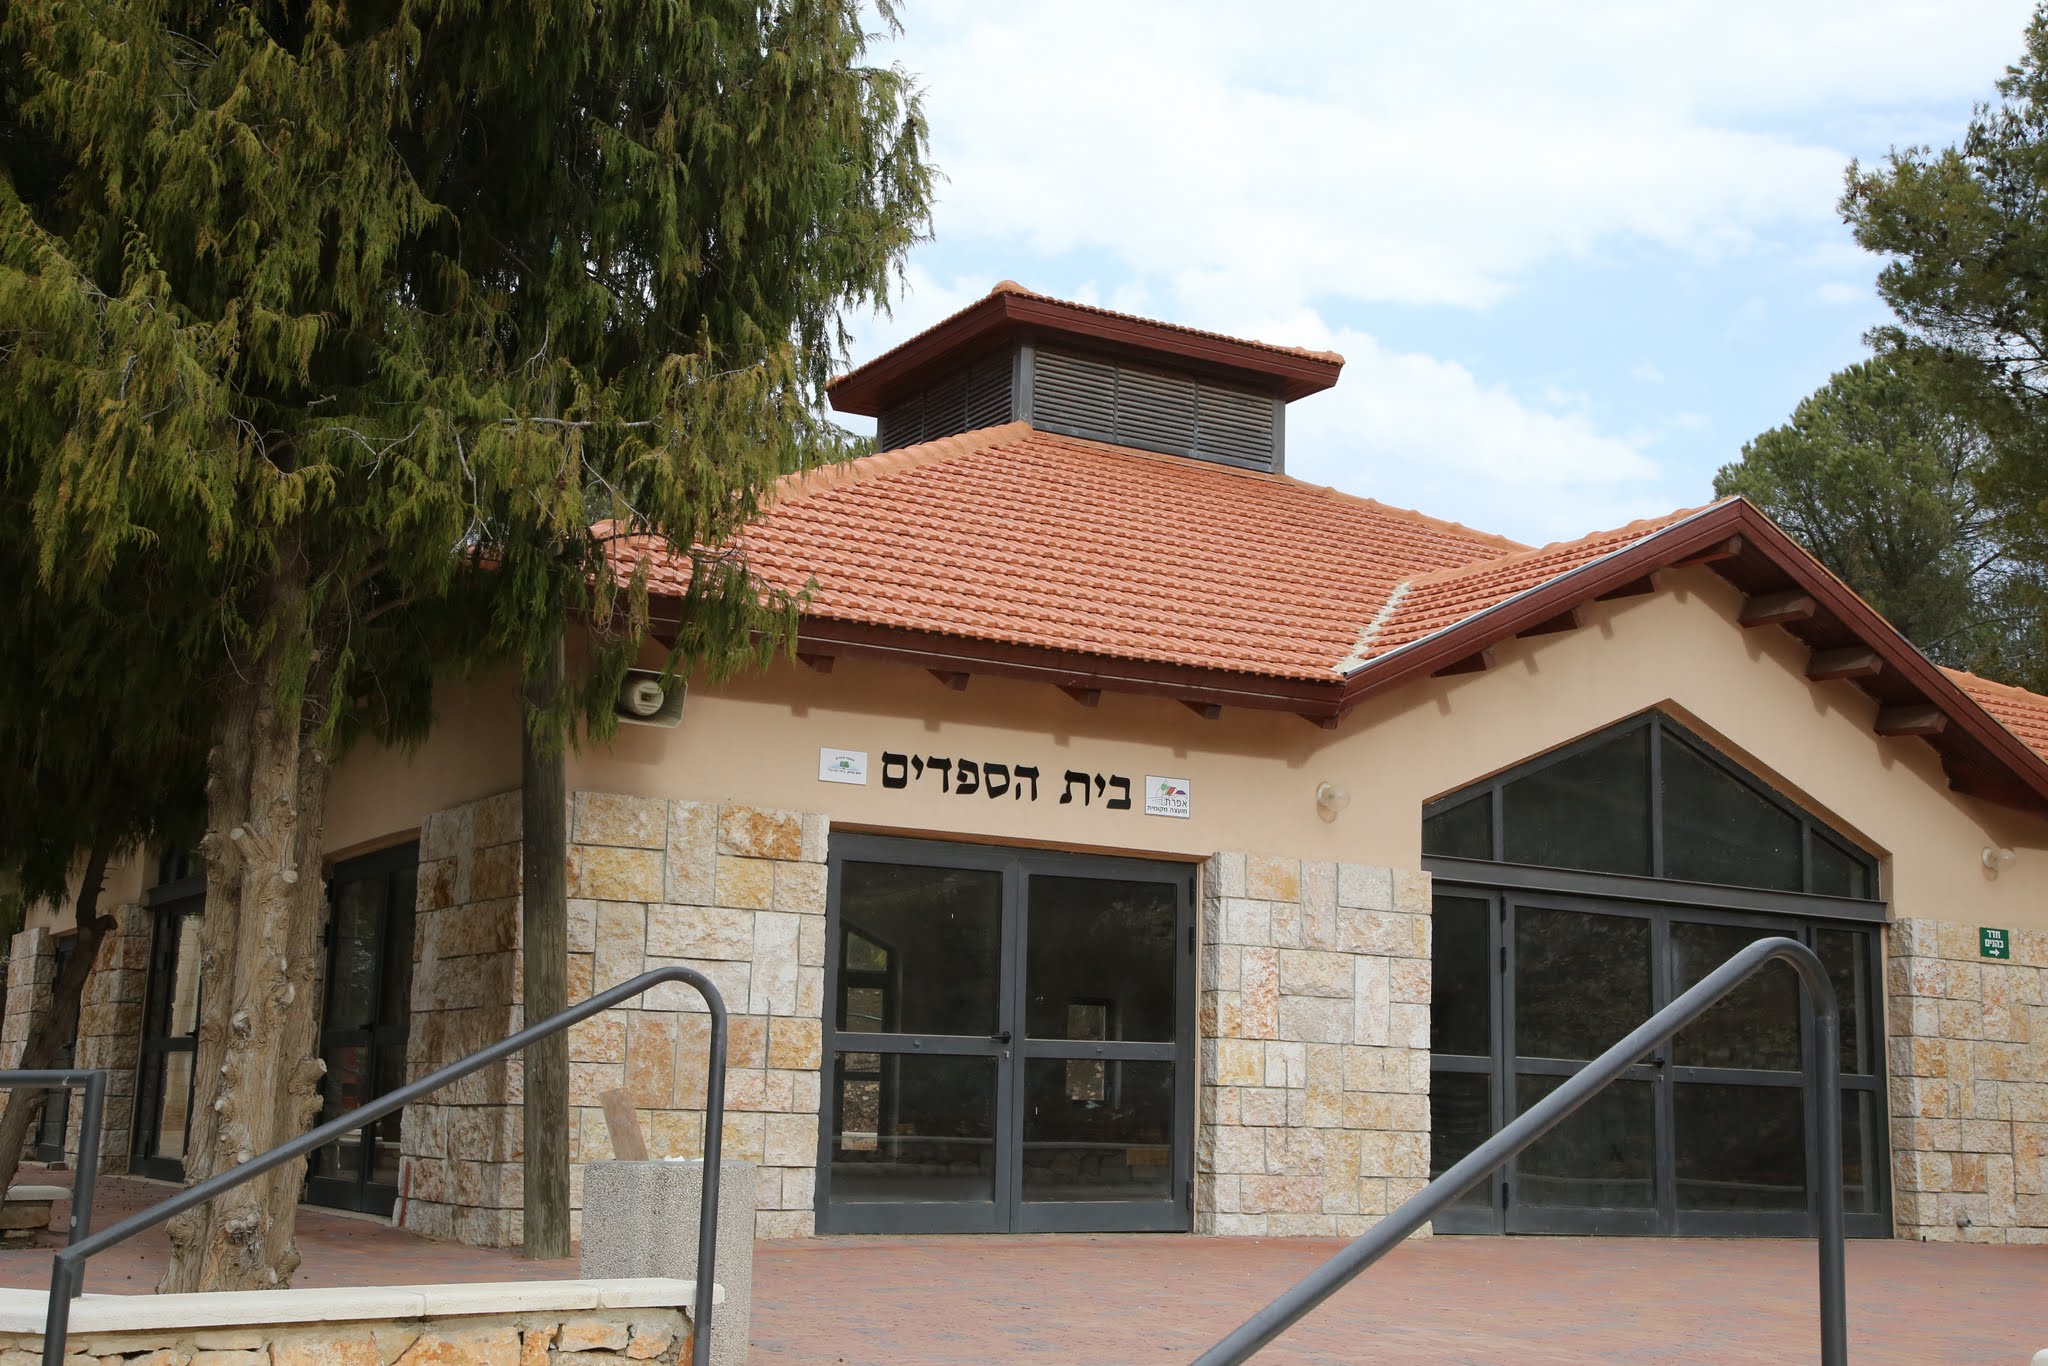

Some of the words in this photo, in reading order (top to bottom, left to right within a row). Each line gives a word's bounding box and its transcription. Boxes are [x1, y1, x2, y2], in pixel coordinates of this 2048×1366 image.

[881, 751, 1040, 802] הספדים
[1059, 769, 1132, 810] בית
[1164, 798, 1188, 808] אפרת
[1146, 805, 1168, 813] מקומית
[1169, 807, 1188, 815] מועצה
[1986, 929, 2001, 939] חדר
[1984, 938, 2004, 949] כהנים
